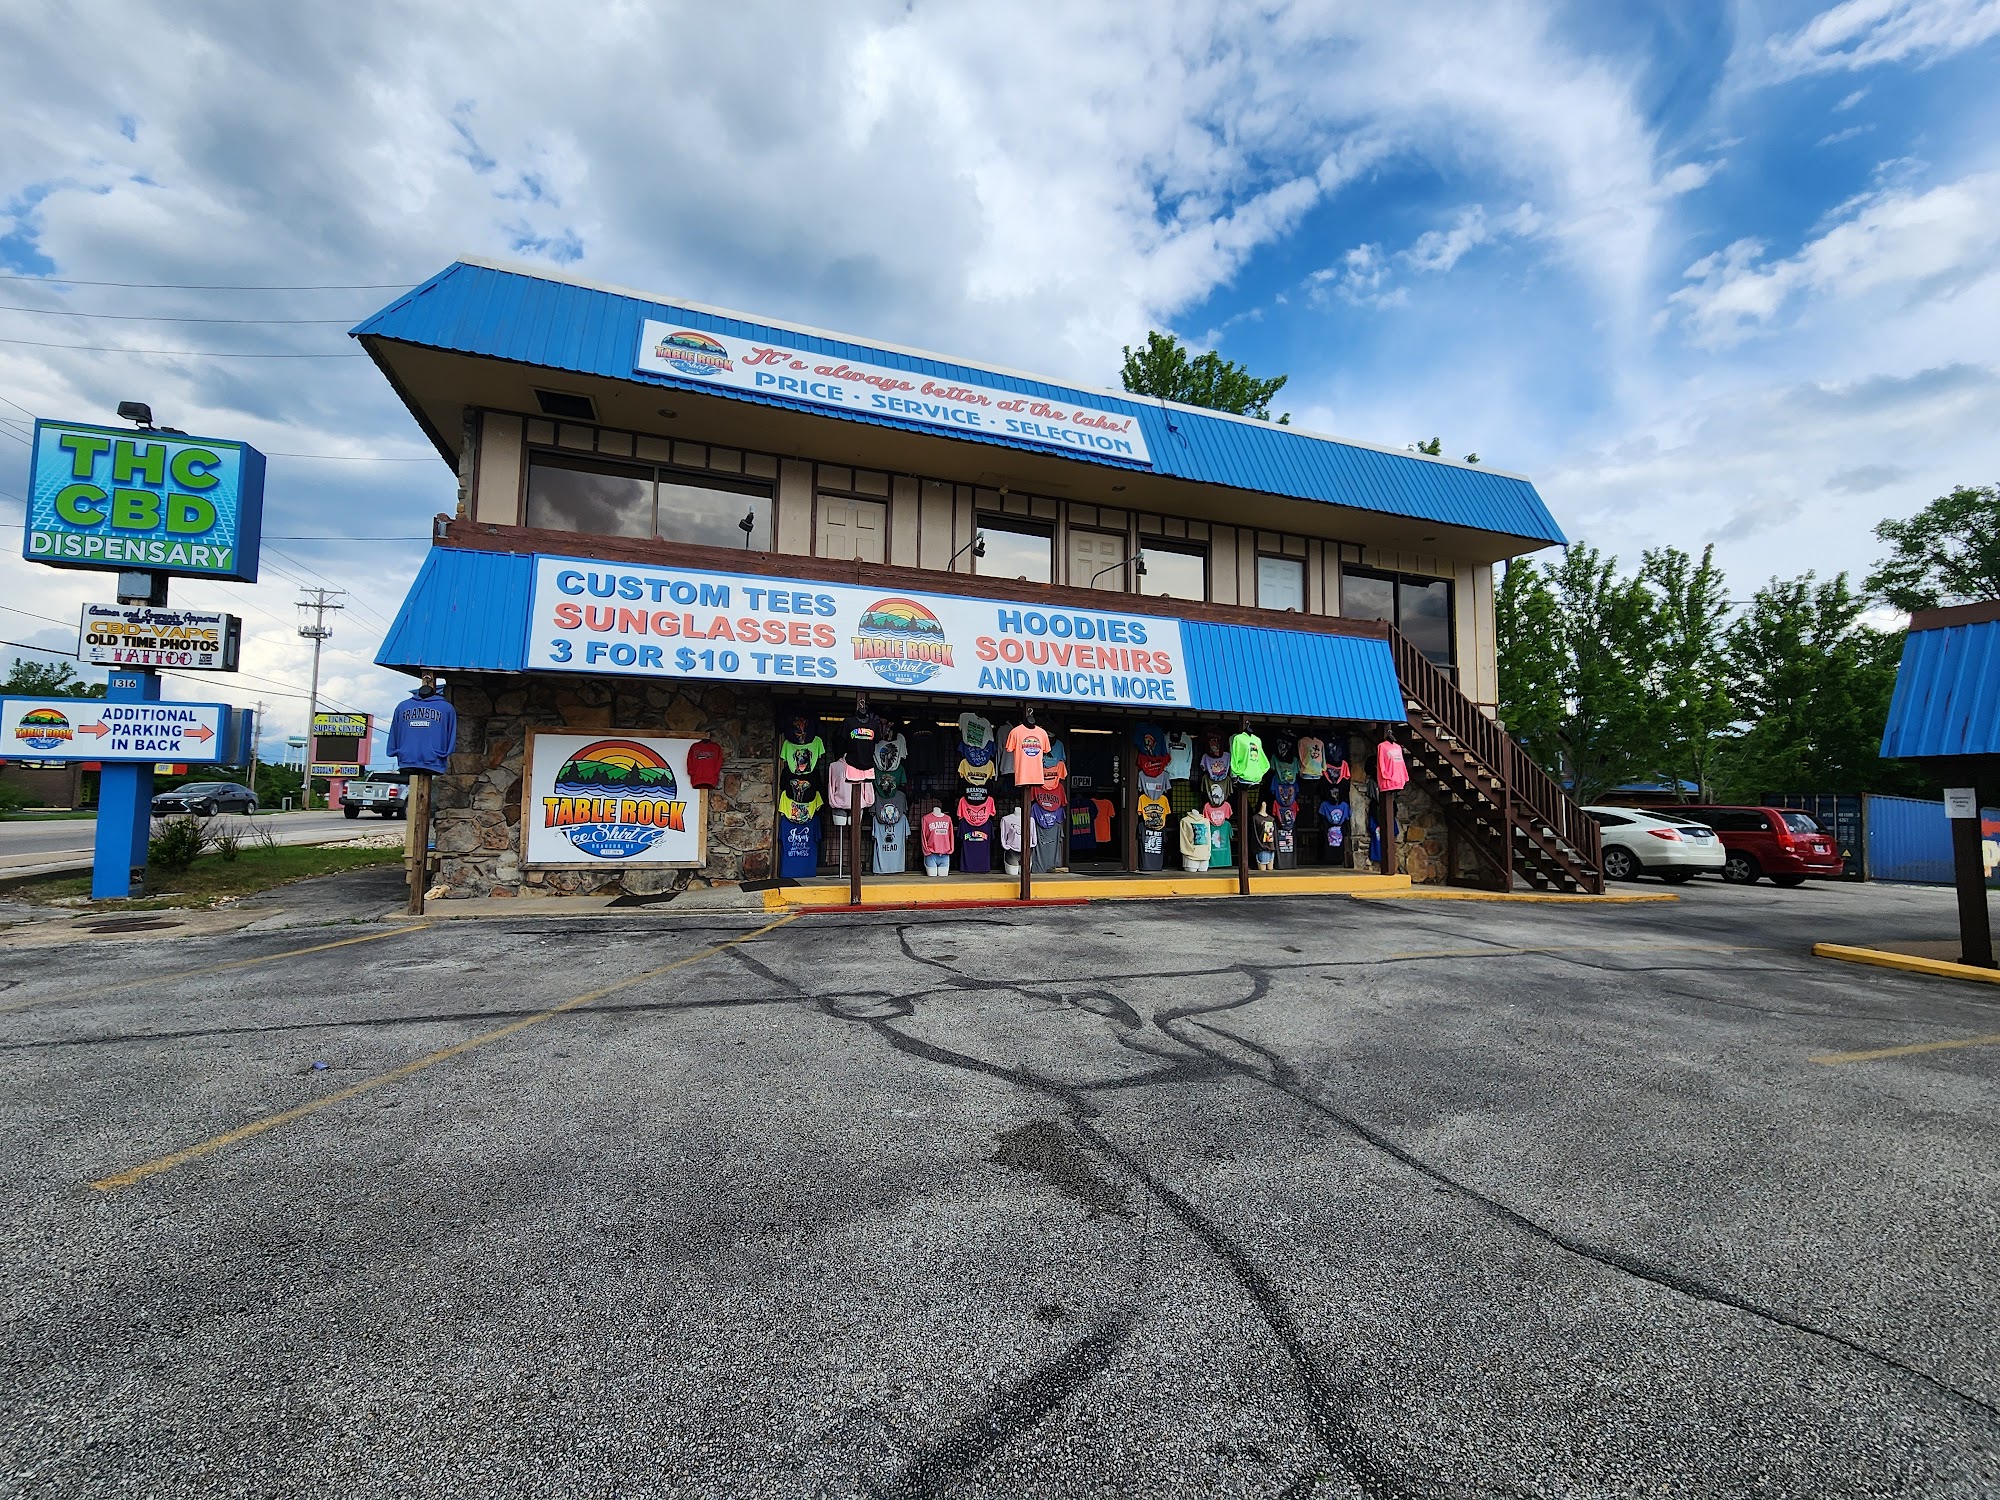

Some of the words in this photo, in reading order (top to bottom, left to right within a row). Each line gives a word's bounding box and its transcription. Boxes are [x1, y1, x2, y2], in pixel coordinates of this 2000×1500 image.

[655, 346, 695, 362] TABLE
[697, 353, 734, 372] ROCK
[742, 346, 808, 370] It's
[813, 363, 915, 392] always
[920, 381, 992, 406] better
[997, 399, 1031, 413] at
[1029, 400, 1067, 421] the
[1072, 411, 1132, 434] lake!
[756, 371, 843, 401] PRICE
[872, 393, 981, 426] SERVICE
[1005, 419, 1133, 454] SELECTION
[60, 434, 221, 489] THC
[55, 483, 216, 534] CBD
[30, 532, 231, 568] DISPENSARY
[556, 570, 730, 608] CUSTOM
[742, 586, 837, 617] TEES
[90, 621, 218, 640] CBD-VAPE
[553, 602, 837, 649] SUNGLASSES
[998, 608, 1148, 644] HOODIES
[86, 633, 118, 646] OLD
[122, 636, 157, 649] TIME
[160, 638, 219, 652] PHOTOS
[112, 648, 192, 665] TATTOO
[851, 637, 905, 660] TABLE
[906, 641, 955, 668] ROCK
[975, 636, 1173, 674] SOUVENIRS
[550, 639, 572, 662] 3
[585, 641, 663, 669] FOR
[675, 647, 739, 672] $10
[750, 652, 838, 678] TEES
[113, 680, 136, 688] 1316
[978, 666, 1030, 691] AND
[1037, 670, 1106, 697] MUCH
[1112, 675, 1176, 700] MORE
[102, 708, 196, 722] ADDITIONAL
[314, 724, 336, 732] SUPER
[338, 725, 364, 733] CENTER
[328, 716, 351, 724] TICKET
[15, 728, 45, 739] TABLE
[46, 728, 73, 740] ROCK
[112, 724, 182, 737] PARKING
[112, 739, 128, 750] IN
[135, 740, 180, 751] BACK
[1073, 776, 1091, 786] OPEN
[543, 797, 616, 829] TABLE
[620, 800, 687, 832] ROCK
[557, 825, 591, 846] Tee
[592, 823, 638, 842] Shirt
